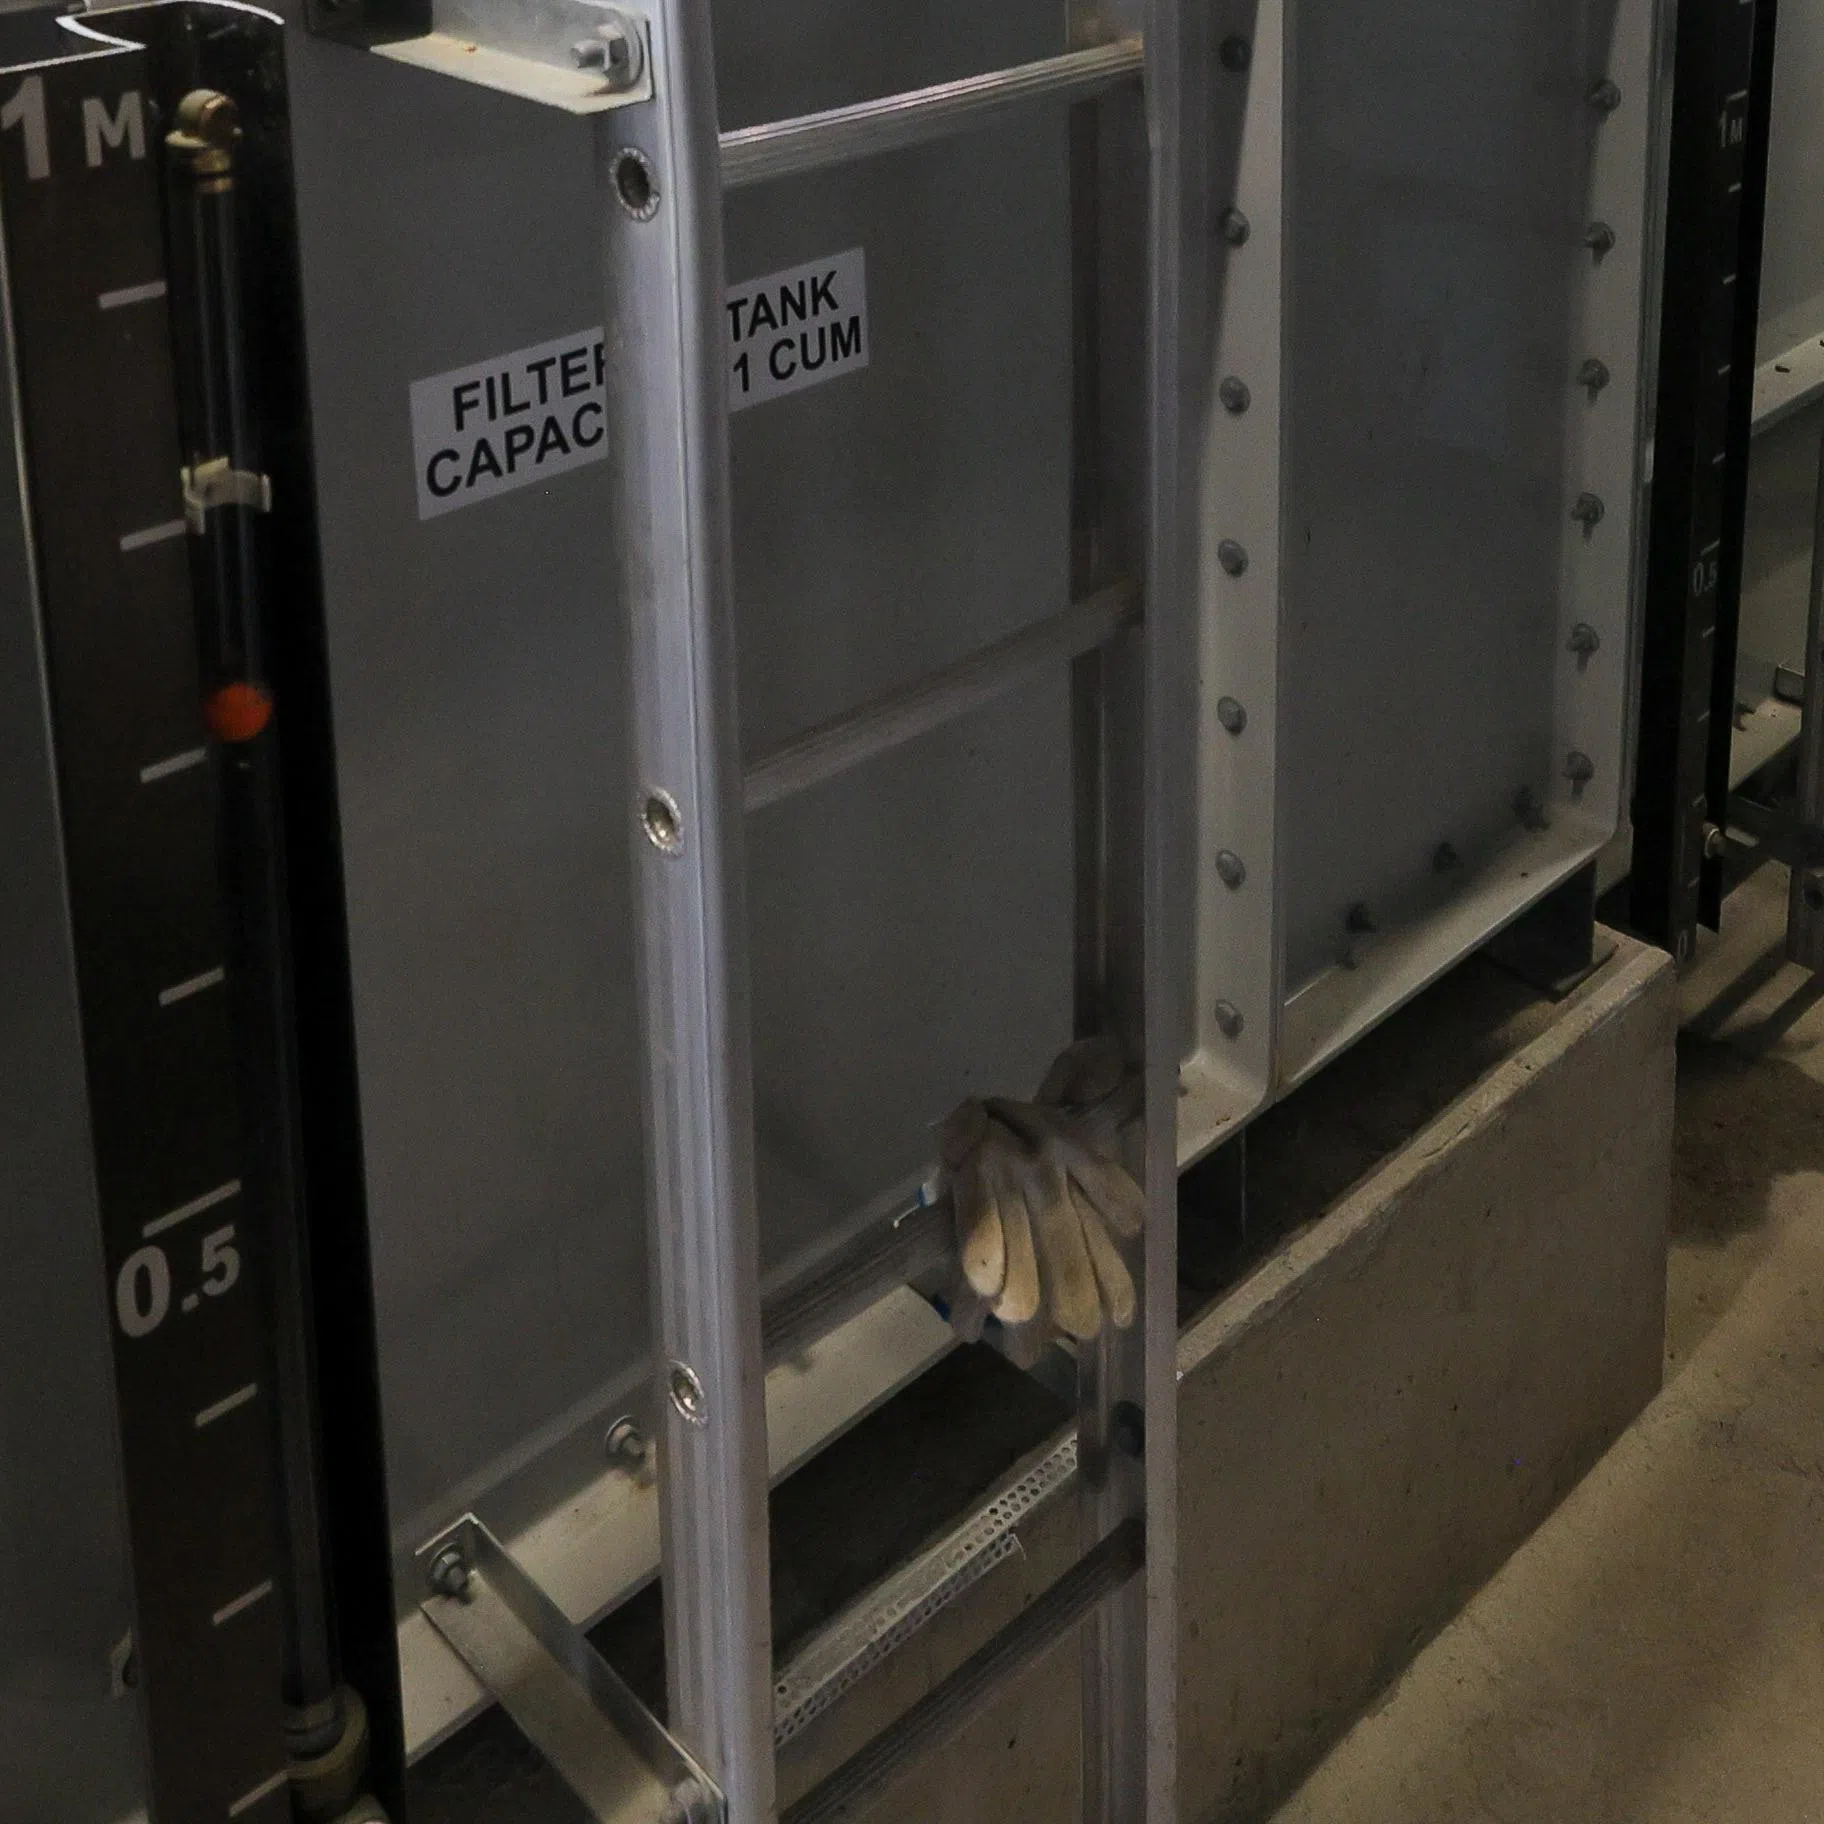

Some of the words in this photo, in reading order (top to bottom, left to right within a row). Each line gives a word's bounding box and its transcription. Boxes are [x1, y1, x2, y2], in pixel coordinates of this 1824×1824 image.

[0, 73, 51, 180] 1
[82, 89, 146, 168] M
[726, 270, 840, 342] TANK
[425, 401, 606, 498] CAPAC
[768, 315, 862, 381] CUM
[116, 1223, 241, 1338] 0.5
